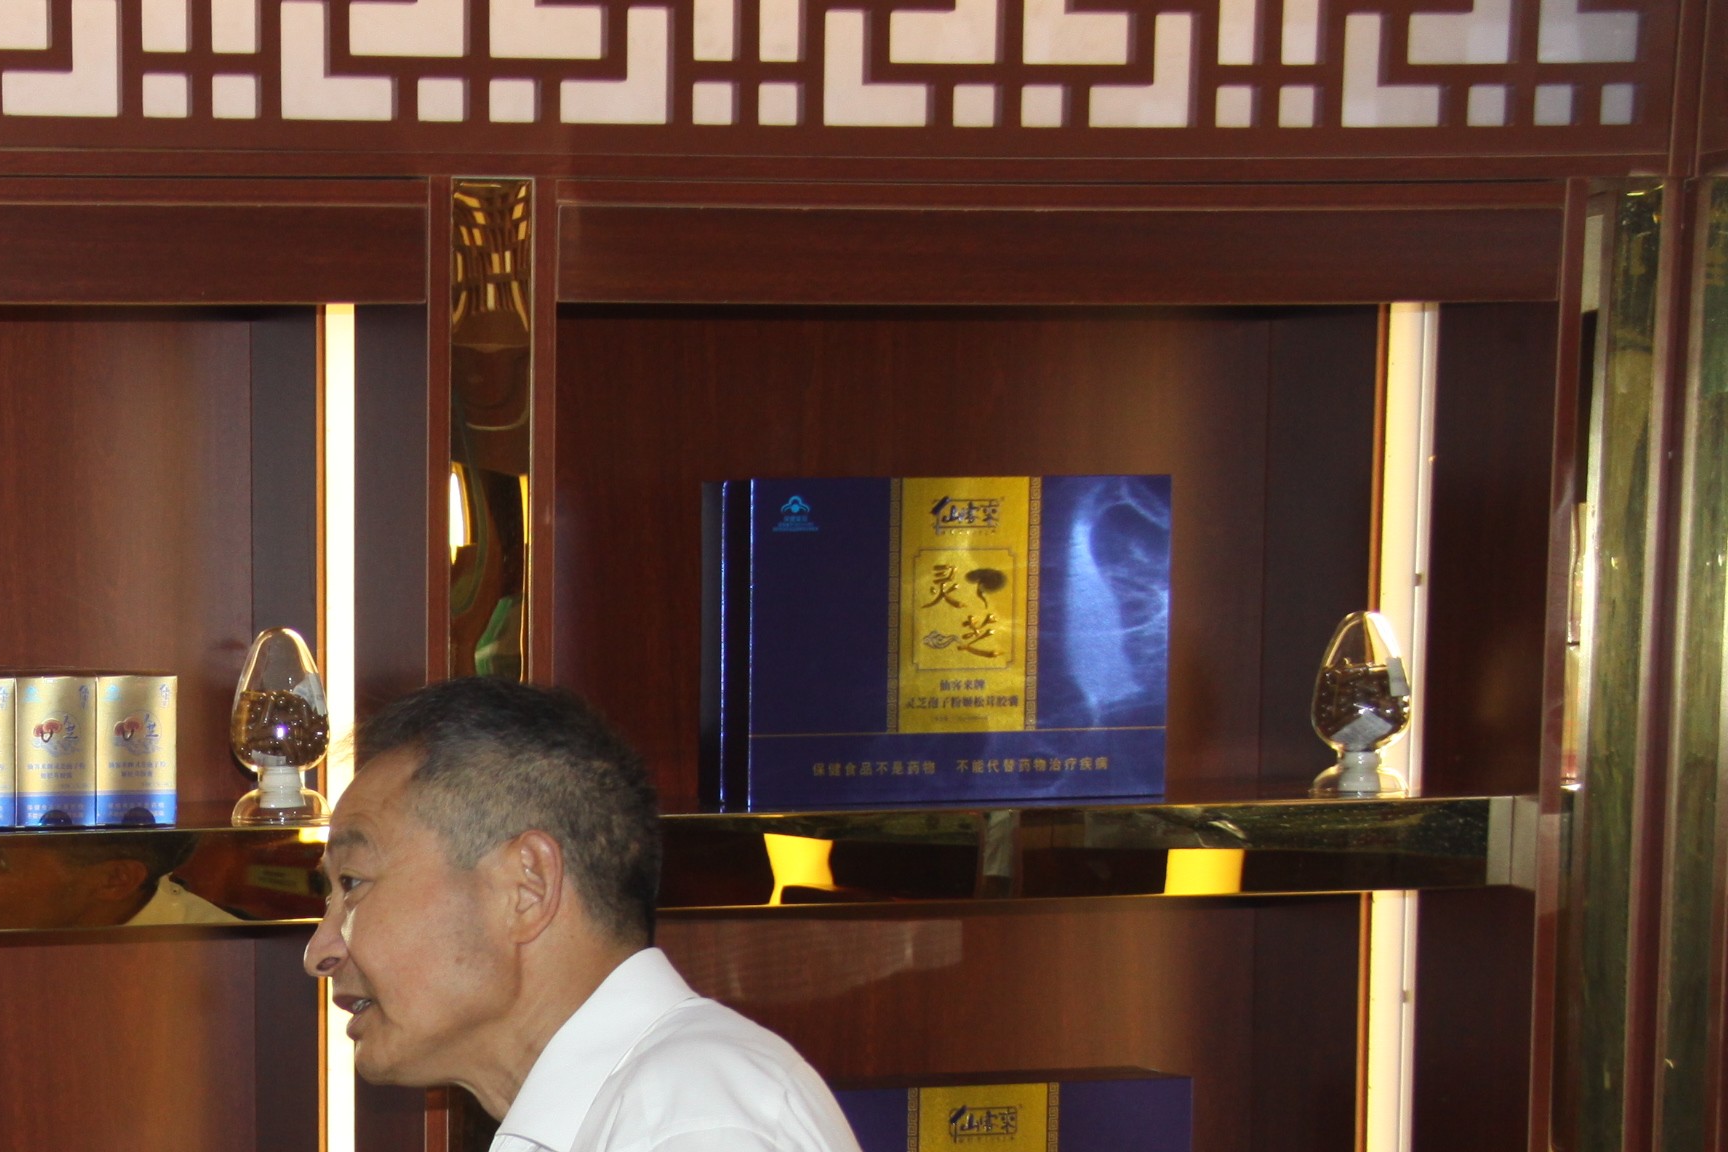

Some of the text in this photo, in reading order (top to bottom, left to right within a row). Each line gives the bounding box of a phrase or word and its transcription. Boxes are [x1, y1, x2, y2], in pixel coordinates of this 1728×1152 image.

[812, 757, 1108, 777] 保健食品不是药物 不能代替药物治疗疾病
